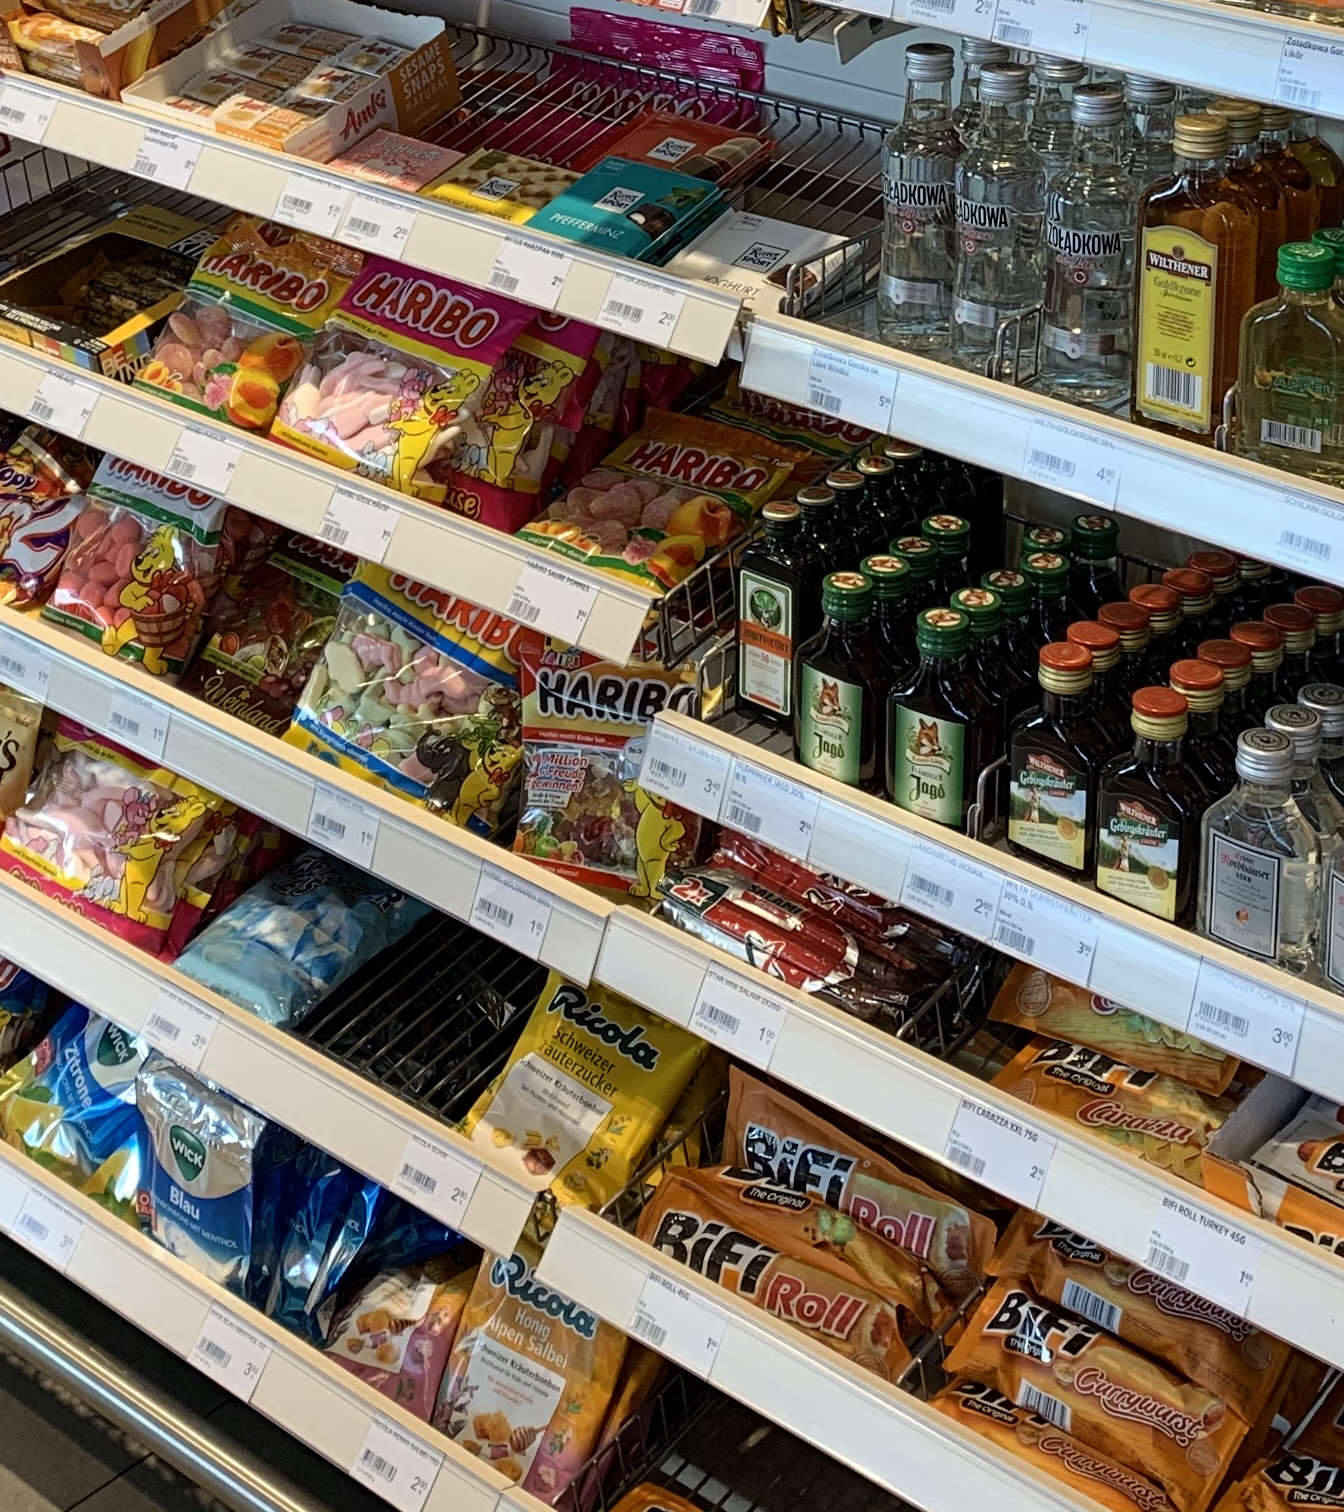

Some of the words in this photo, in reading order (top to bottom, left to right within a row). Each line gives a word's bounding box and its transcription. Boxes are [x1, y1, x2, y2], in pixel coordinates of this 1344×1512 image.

[398, 40, 443, 77] SESAME
[549, 213, 625, 242] PFEFFERMINZ
[1147, 249, 1209, 280] WILTHENER
[201, 252, 329, 316] HARIBO
[1152, 275, 1202, 297] Goldkrone
[351, 272, 500, 351] HARIBO
[625, 440, 769, 490] HARIBO
[741, 623, 791, 654] Jägermeister
[200, 671, 287, 734] Weinland
[813, 733, 845, 760] Jagd
[1018, 769, 1076, 794] Gebirgskräuter
[1027, 754, 1066, 779] WILTHENER
[909, 775, 946, 802] Jagd
[1109, 816, 1168, 843] Gebirgskräuter
[1118, 800, 1158, 826] WILTHENER
[548, 984, 659, 1073] Ricola
[550, 1025, 617, 1076] Schweizer
[59, 1037, 95, 1111] Zitrone
[1076, 1098, 1194, 1145] Carazza
[171, 1135, 204, 1169] WICK
[168, 1186, 201, 1222] Blau
[1162, 1195, 1181, 1211] BIFI
[1178, 1204, 1200, 1221] ROLL
[1198, 1211, 1230, 1237] TURKEY
[1228, 1229, 1246, 1246] 45G
[850, 1195, 936, 1262] Roll
[513, 1306, 552, 1341] Honig
[765, 1274, 867, 1342] Roll
[483, 1316, 529, 1352] Alpen
[528, 1334, 570, 1372] Salbei
[1073, 1366, 1206, 1445] Currywurst
